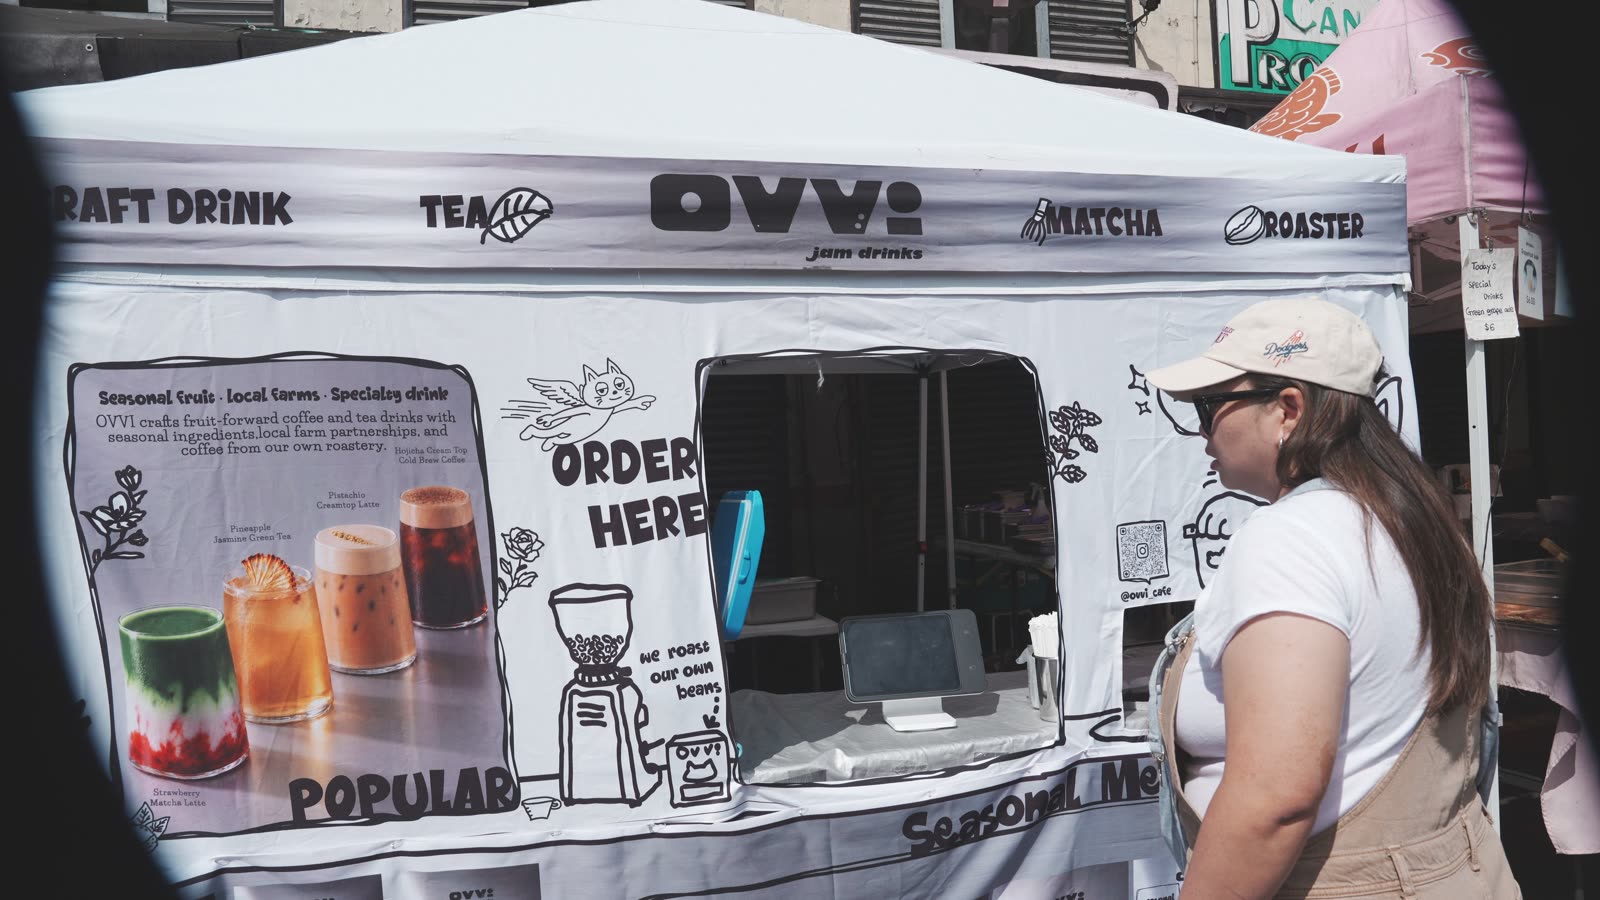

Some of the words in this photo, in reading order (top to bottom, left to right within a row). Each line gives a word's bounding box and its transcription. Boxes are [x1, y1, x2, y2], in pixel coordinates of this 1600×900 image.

[420, 195, 487, 229] TEA
[1046, 206, 1163, 236] MATCHA
[1265, 211, 1364, 239] ROASTER
[805, 246, 853, 262] jam
[858, 246, 923, 260] drinks
[1471, 261, 1497, 274] Today's
[1485, 323, 1495, 331] $6
[1263, 342, 1308, 357] Dodgers
[99, 390, 173, 405] Seasonal
[176, 389, 216, 404] fruit
[271, 388, 320, 402] farms
[330, 386, 402, 403] Specialty
[405, 386, 449, 401] drink
[96, 414, 136, 428] OVVI
[139, 415, 180, 428] crafts
[184, 411, 278, 427] fruit-forward
[282, 411, 324, 424] coffee
[327, 410, 353, 423] and
[355, 413, 377, 423] tea
[380, 410, 423, 423] drinks
[427, 410, 457, 423] with
[108, 429, 169, 443] seasonal
[294, 425, 327, 438] farm
[330, 424, 421, 439] partnerships,
[423, 424, 449, 437] and
[181, 442, 224, 456] coffee
[227, 441, 260, 454] from
[264, 444, 289, 453] our
[293, 443, 322, 452] own
[326, 441, 387, 453] roastery.
[394, 446, 425, 456] Hojicha
[426, 446, 452, 454] Cream
[453, 446, 468, 455] Top
[398, 456, 417, 464] Cold
[419, 456, 440, 464] Brew
[441, 455, 466, 464] Coffee
[552, 437, 698, 487] ORDER
[328, 491, 366, 499] Pistachio
[316, 501, 357, 510] Creamtop
[358, 500, 380, 508] Latte
[230, 524, 271, 533] Pineapple
[587, 492, 708, 549] HERE
[213, 535, 247, 544] Jasmine
[249, 534, 275, 542] Green
[276, 532, 292, 540] Tea
[1120, 586, 1172, 602] @ovvi_cafe
[640, 650, 661, 664] we
[667, 640, 711, 660] roast
[650, 667, 680, 684] our
[682, 661, 714, 677] own
[676, 681, 723, 700] beans
[153, 788, 201, 799] Strawberry
[288, 766, 516, 823] POPULAR
[150, 799, 182, 807] Matcha
[184, 799, 207, 807] Latte
[902, 767, 1082, 859] Seasonal
